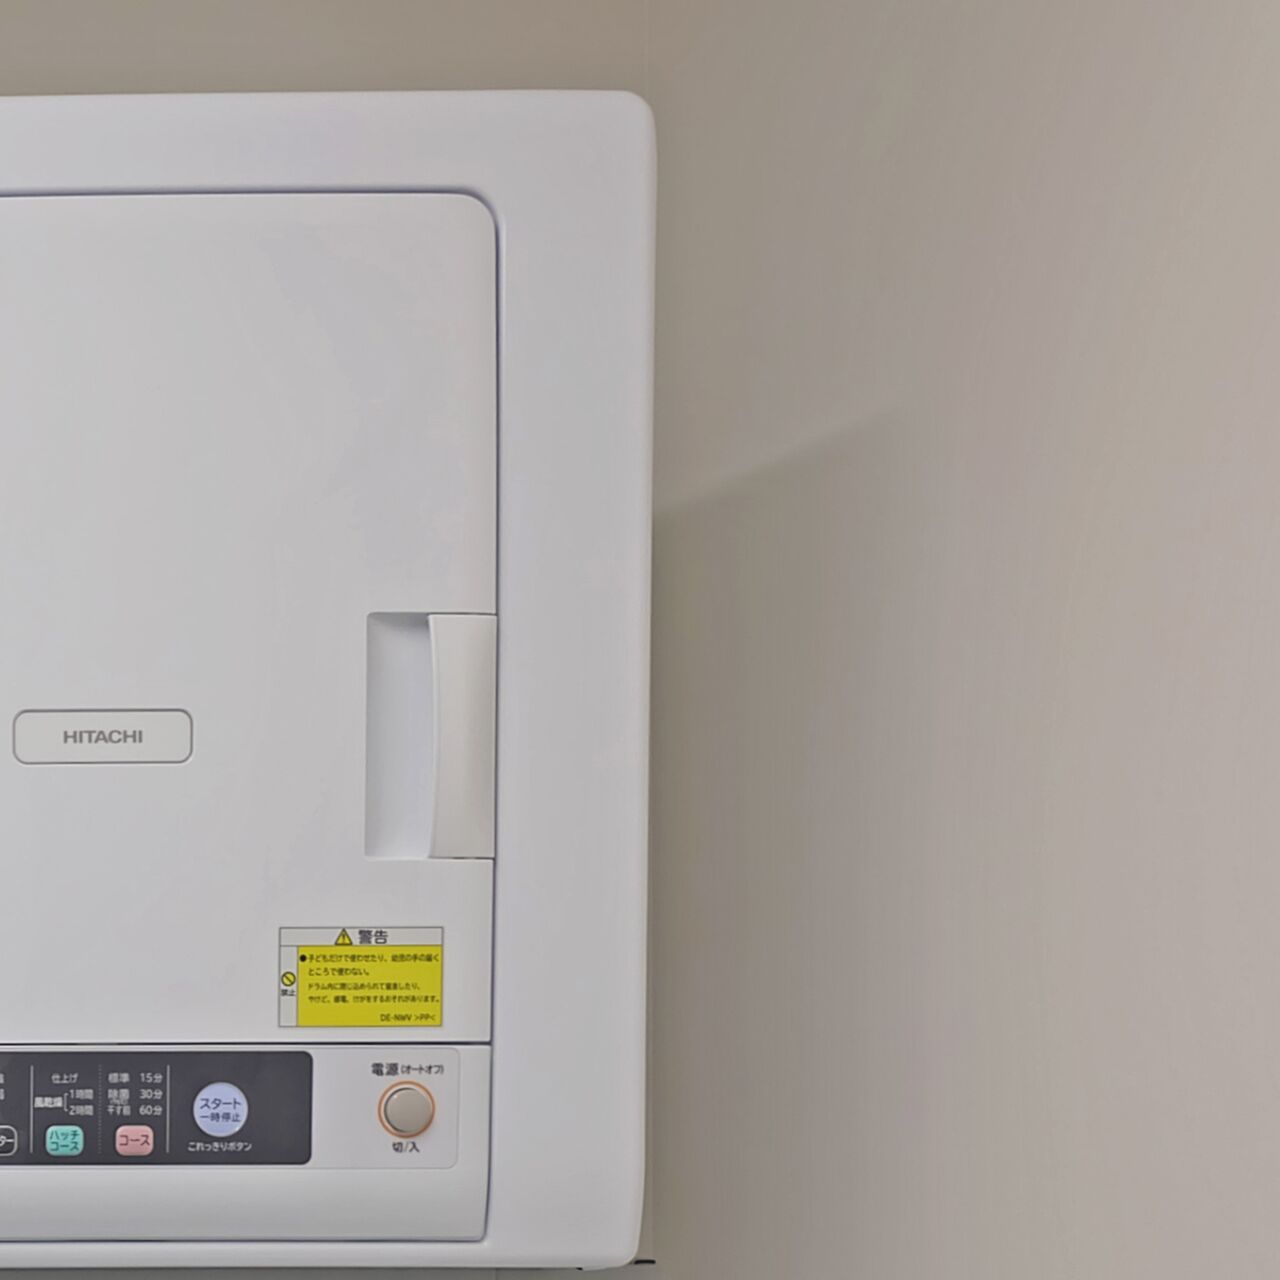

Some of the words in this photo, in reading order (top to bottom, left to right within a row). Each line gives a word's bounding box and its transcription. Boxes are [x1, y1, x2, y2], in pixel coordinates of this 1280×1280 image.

[64, 730, 143, 744] HITACHI
[358, 930, 388, 944] 警告
[371, 1063, 399, 1075] 電源
[51, 1074, 78, 1084] 仕上げ
[108, 1072, 129, 1083] 標準
[140, 1072, 163, 1083] 15分
[69, 1089, 93, 1100] 1時間
[140, 1089, 163, 1100] 30分
[199, 1097, 241, 1109] スタート
[69, 1105, 93, 1116] 2時間
[139, 1105, 162, 1116] 60分
[199, 1111, 240, 1122] 一時停止
[50, 1130, 78, 1141] ハッチ
[120, 1134, 150, 1146] コース
[50, 1142, 80, 1152] コース
[188, 1142, 252, 1152] これっきりボタン
